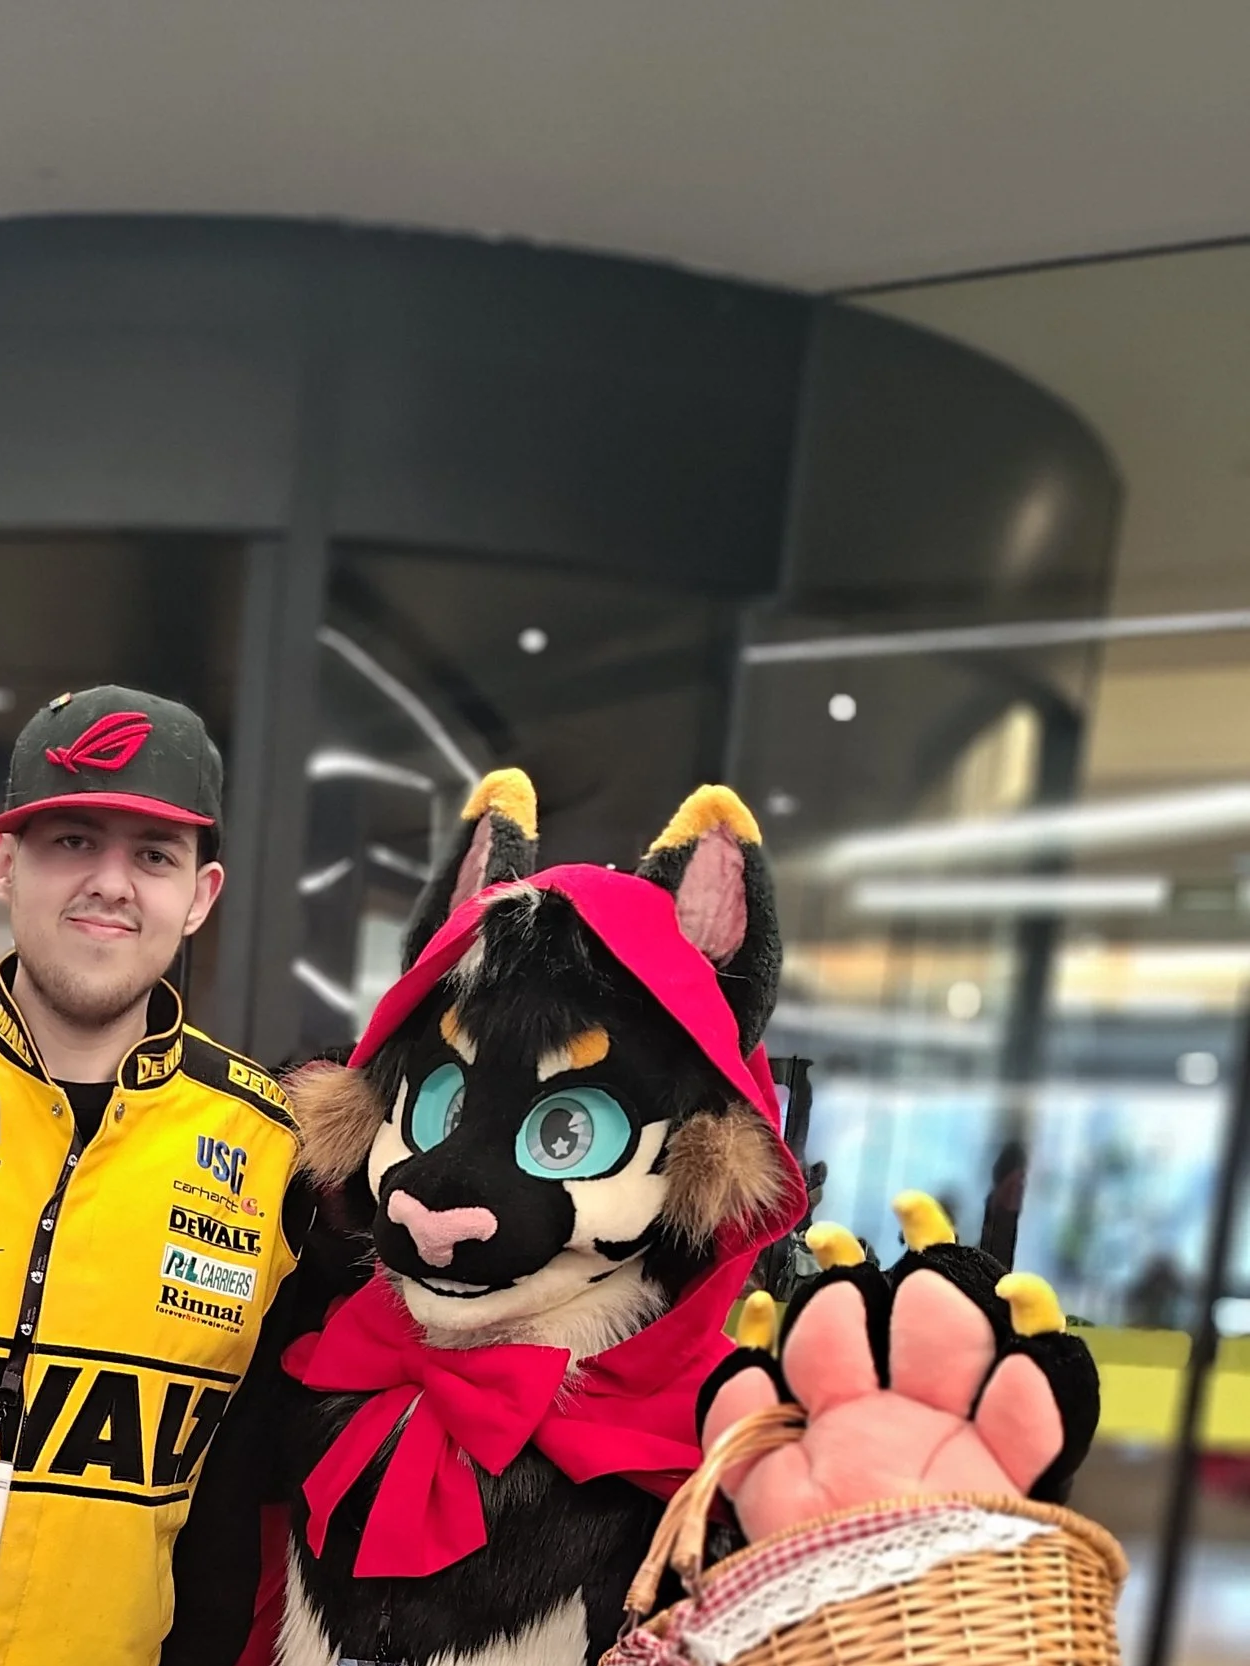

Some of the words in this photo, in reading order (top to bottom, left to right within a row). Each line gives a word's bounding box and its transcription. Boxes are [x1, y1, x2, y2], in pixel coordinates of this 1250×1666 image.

[196, 1134, 248, 1197] USG
[172, 1179, 239, 1214] carhartt
[199, 1262, 253, 1297] CARRIERS
[158, 1284, 244, 1326] Rinnai
